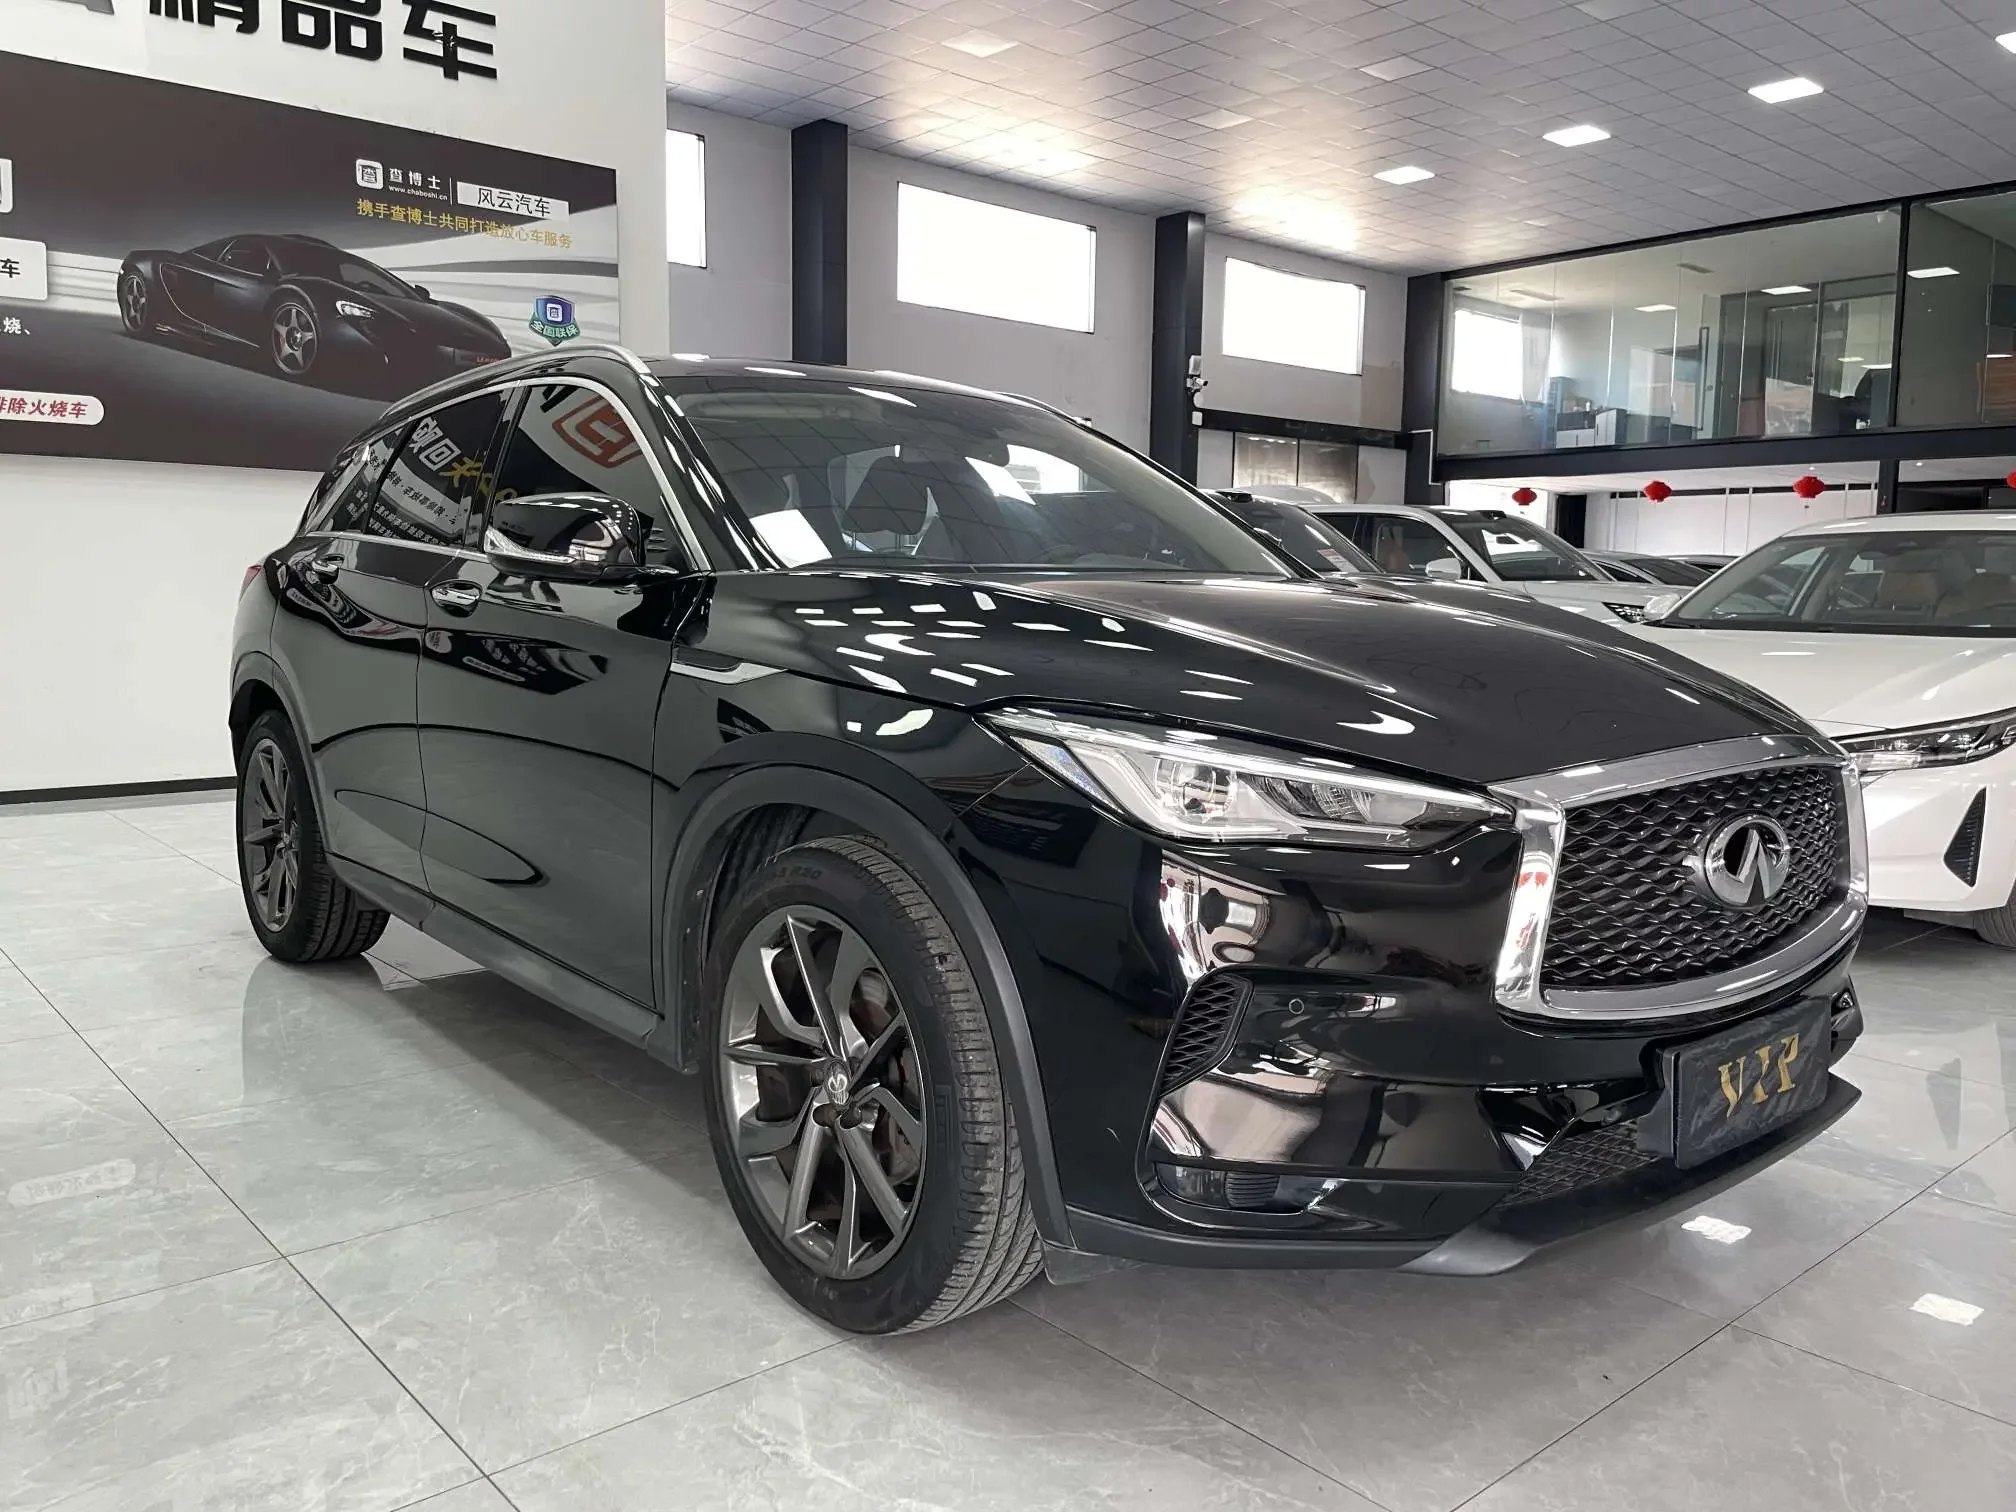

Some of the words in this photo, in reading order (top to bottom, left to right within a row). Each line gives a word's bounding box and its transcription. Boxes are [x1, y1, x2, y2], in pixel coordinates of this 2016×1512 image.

[388, 167, 441, 190] 查博士
[388, 184, 448, 201] www.chaboshi.cn
[478, 187, 551, 218] 风云汽车
[357, 198, 573, 249] 携手查博士共同打造放心车服务
[0, 316, 32, 335] 烧、
[531, 320, 578, 338] 全国联保
[1718, 1033, 1799, 1119] VIP
